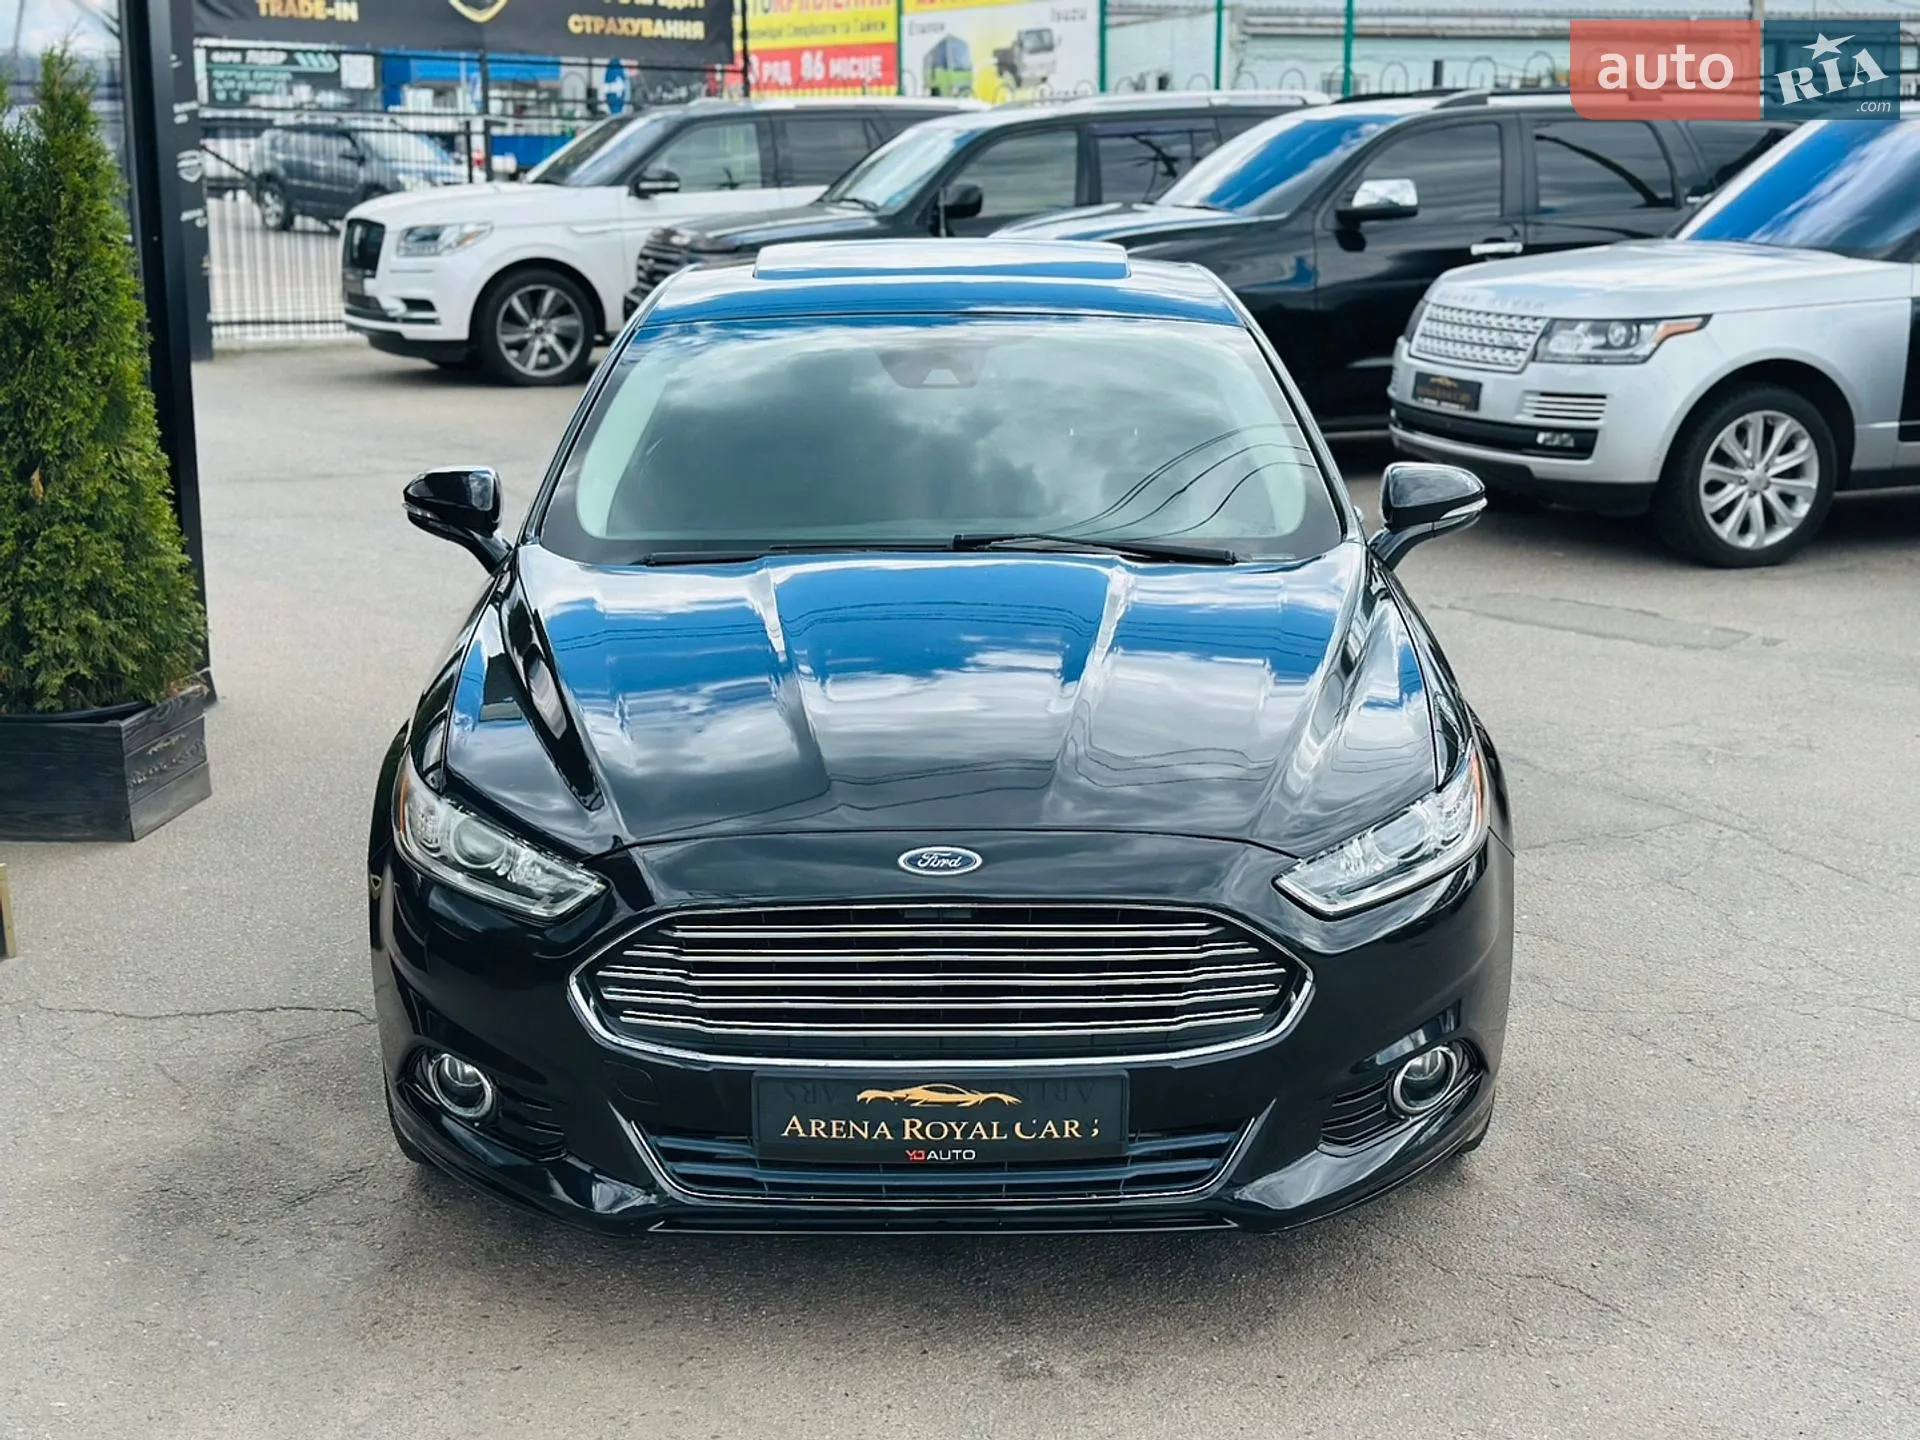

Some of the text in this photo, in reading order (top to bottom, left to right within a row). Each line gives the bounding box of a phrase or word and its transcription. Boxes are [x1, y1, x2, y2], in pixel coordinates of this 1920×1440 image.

[258, 0, 359, 22] TRADE-IN
[567, 13, 705, 40] СТРАХУВАННЯ
[917, 852, 962, 868] Ford
